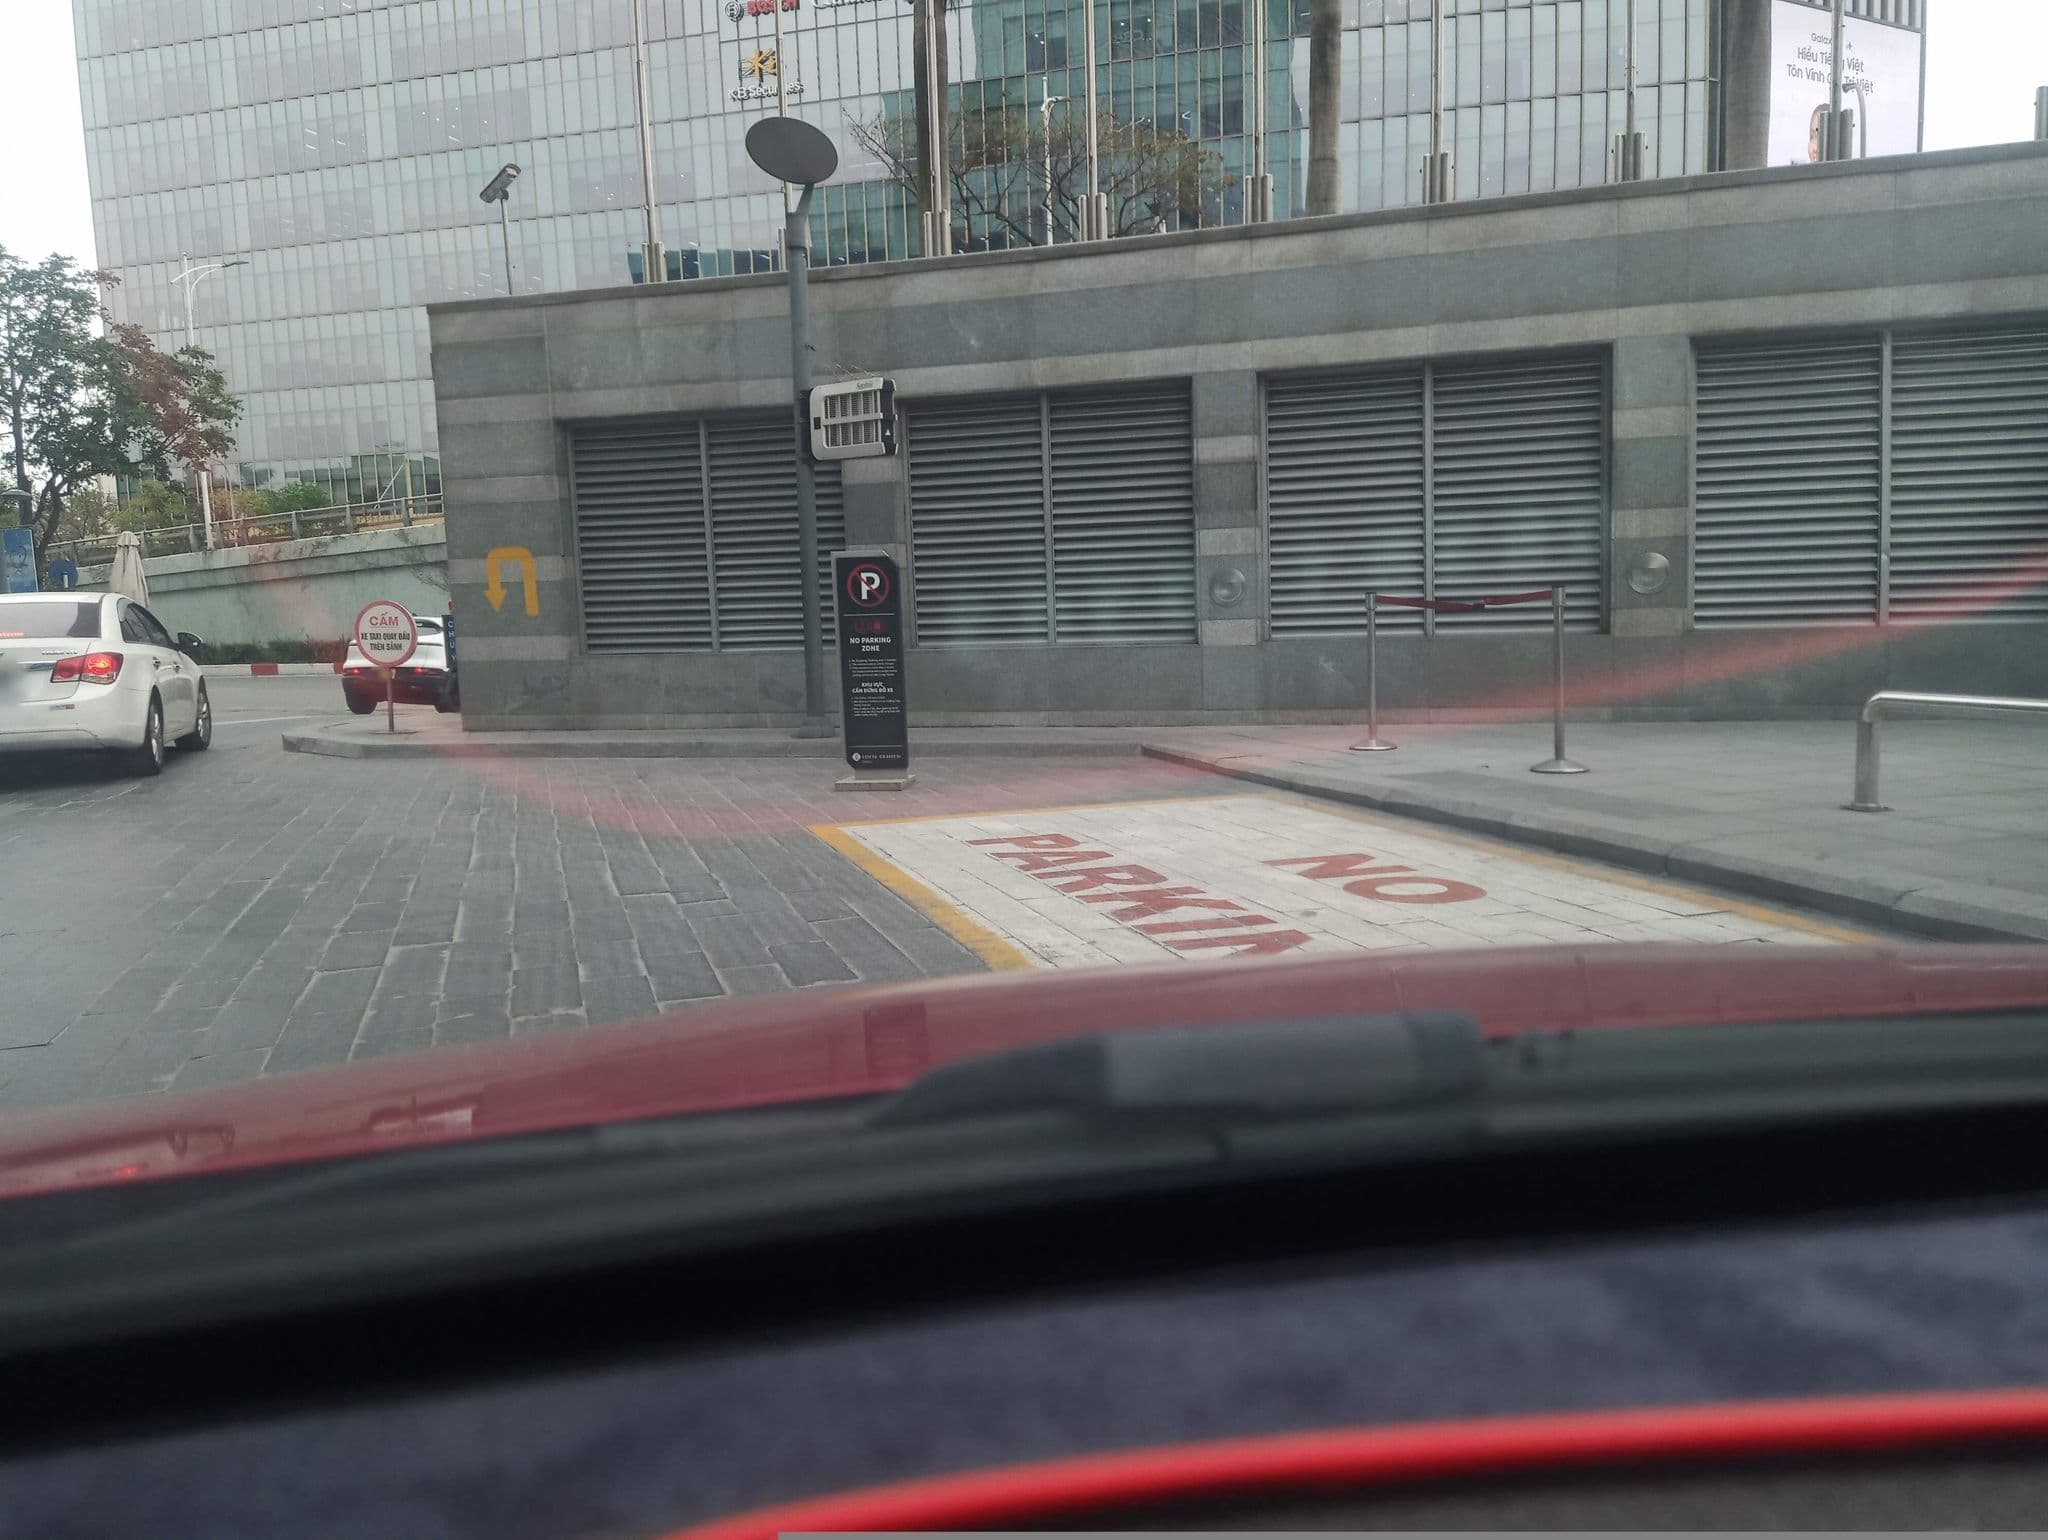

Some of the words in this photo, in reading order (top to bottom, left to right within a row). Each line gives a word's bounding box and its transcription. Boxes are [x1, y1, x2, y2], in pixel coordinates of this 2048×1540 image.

[1810, 33, 1832, 45] Galax
[1797, 45, 1818, 63] Hiểu
[1846, 57, 1865, 75] Việt
[1786, 63, 1803, 79] Tôn
[369, 611, 398, 626] CẤM
[360, 632, 368, 640] XE
[861, 636, 891, 644] PARKING
[1259, 853, 1487, 904] NO
[965, 833, 1313, 955] PARKIN
